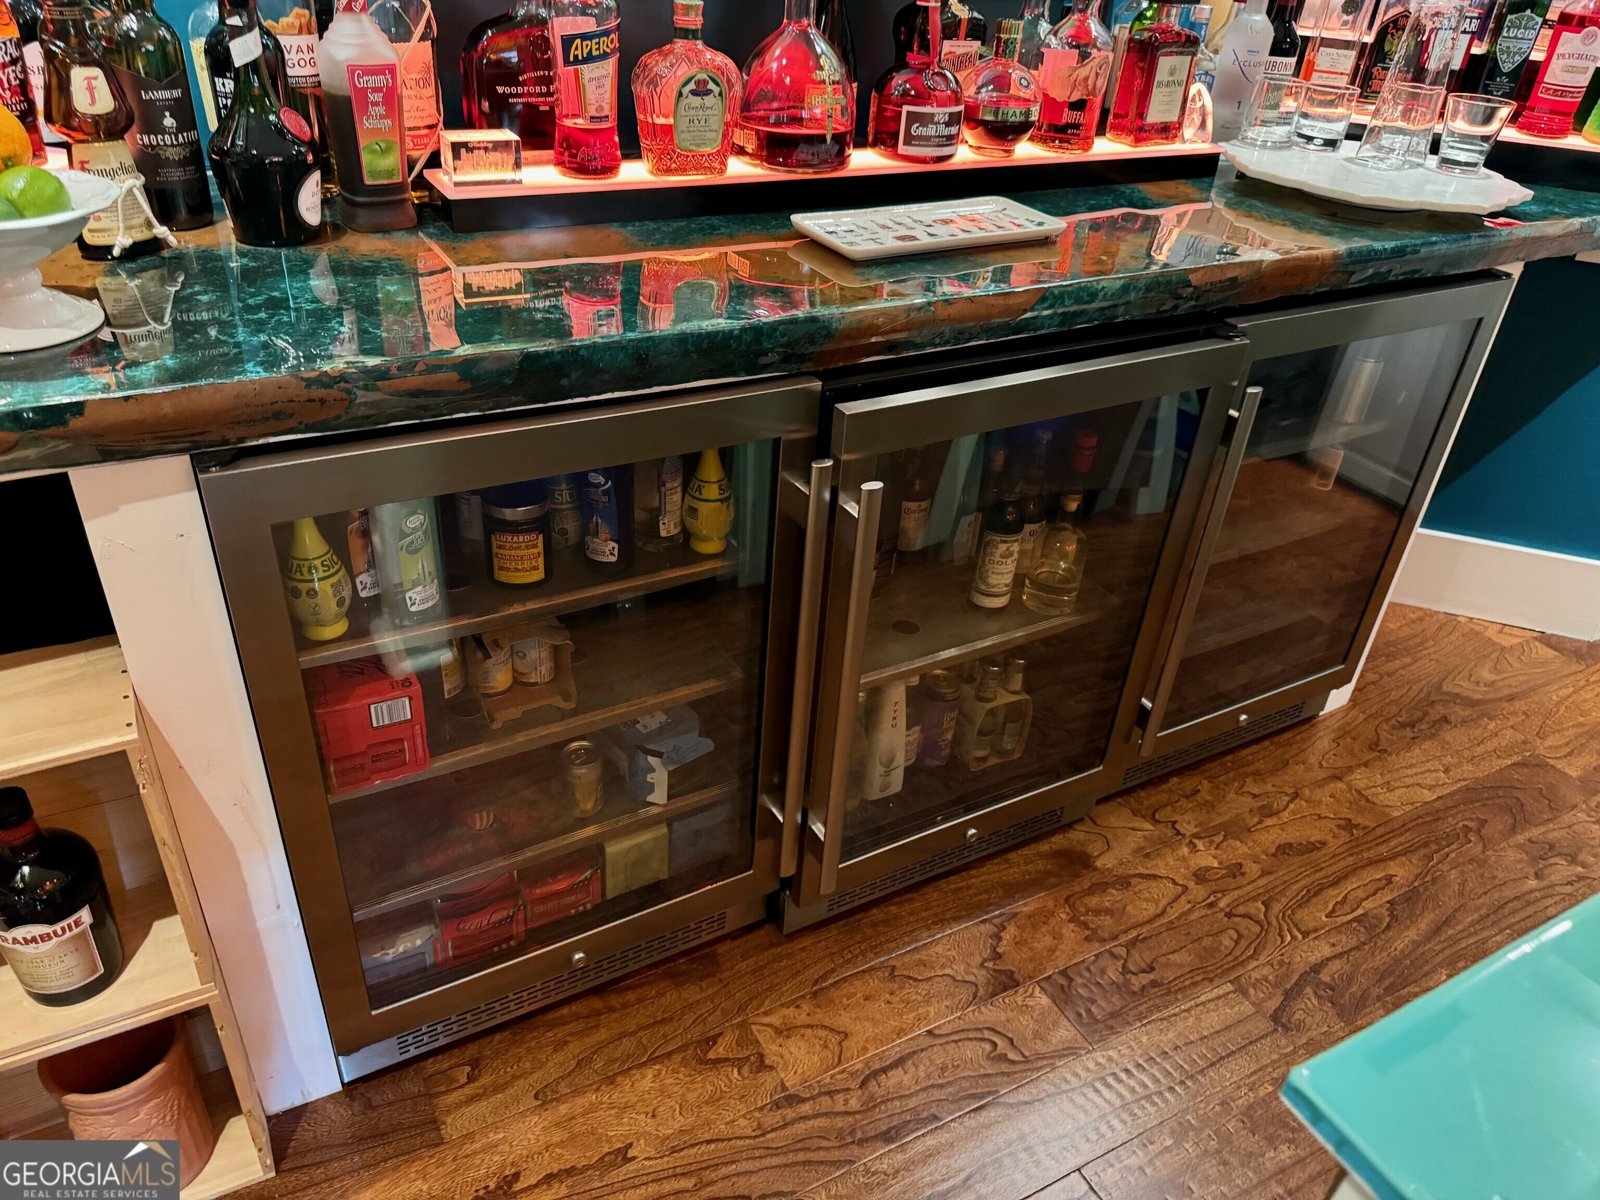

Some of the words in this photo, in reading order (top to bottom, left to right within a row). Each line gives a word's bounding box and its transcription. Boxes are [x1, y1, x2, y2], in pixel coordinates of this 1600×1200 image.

[1502, 27, 1536, 38] LUCID
[284, 43, 315, 56] VAN
[569, 31, 619, 62] APEROL
[286, 56, 317, 69] GOG
[354, 69, 392, 91] Granny's
[141, 88, 182, 100] LAMBERT
[367, 89, 384, 103] Sour
[496, 85, 547, 95] WOODFORD
[367, 103, 386, 118] Apple
[992, 109, 1038, 120] CHAMBO
[363, 117, 393, 132] Schnapps
[688, 117, 710, 125] RYE
[496, 533, 537, 543] LUXARDO
[0, 915, 85, 946] RAMBUIE
